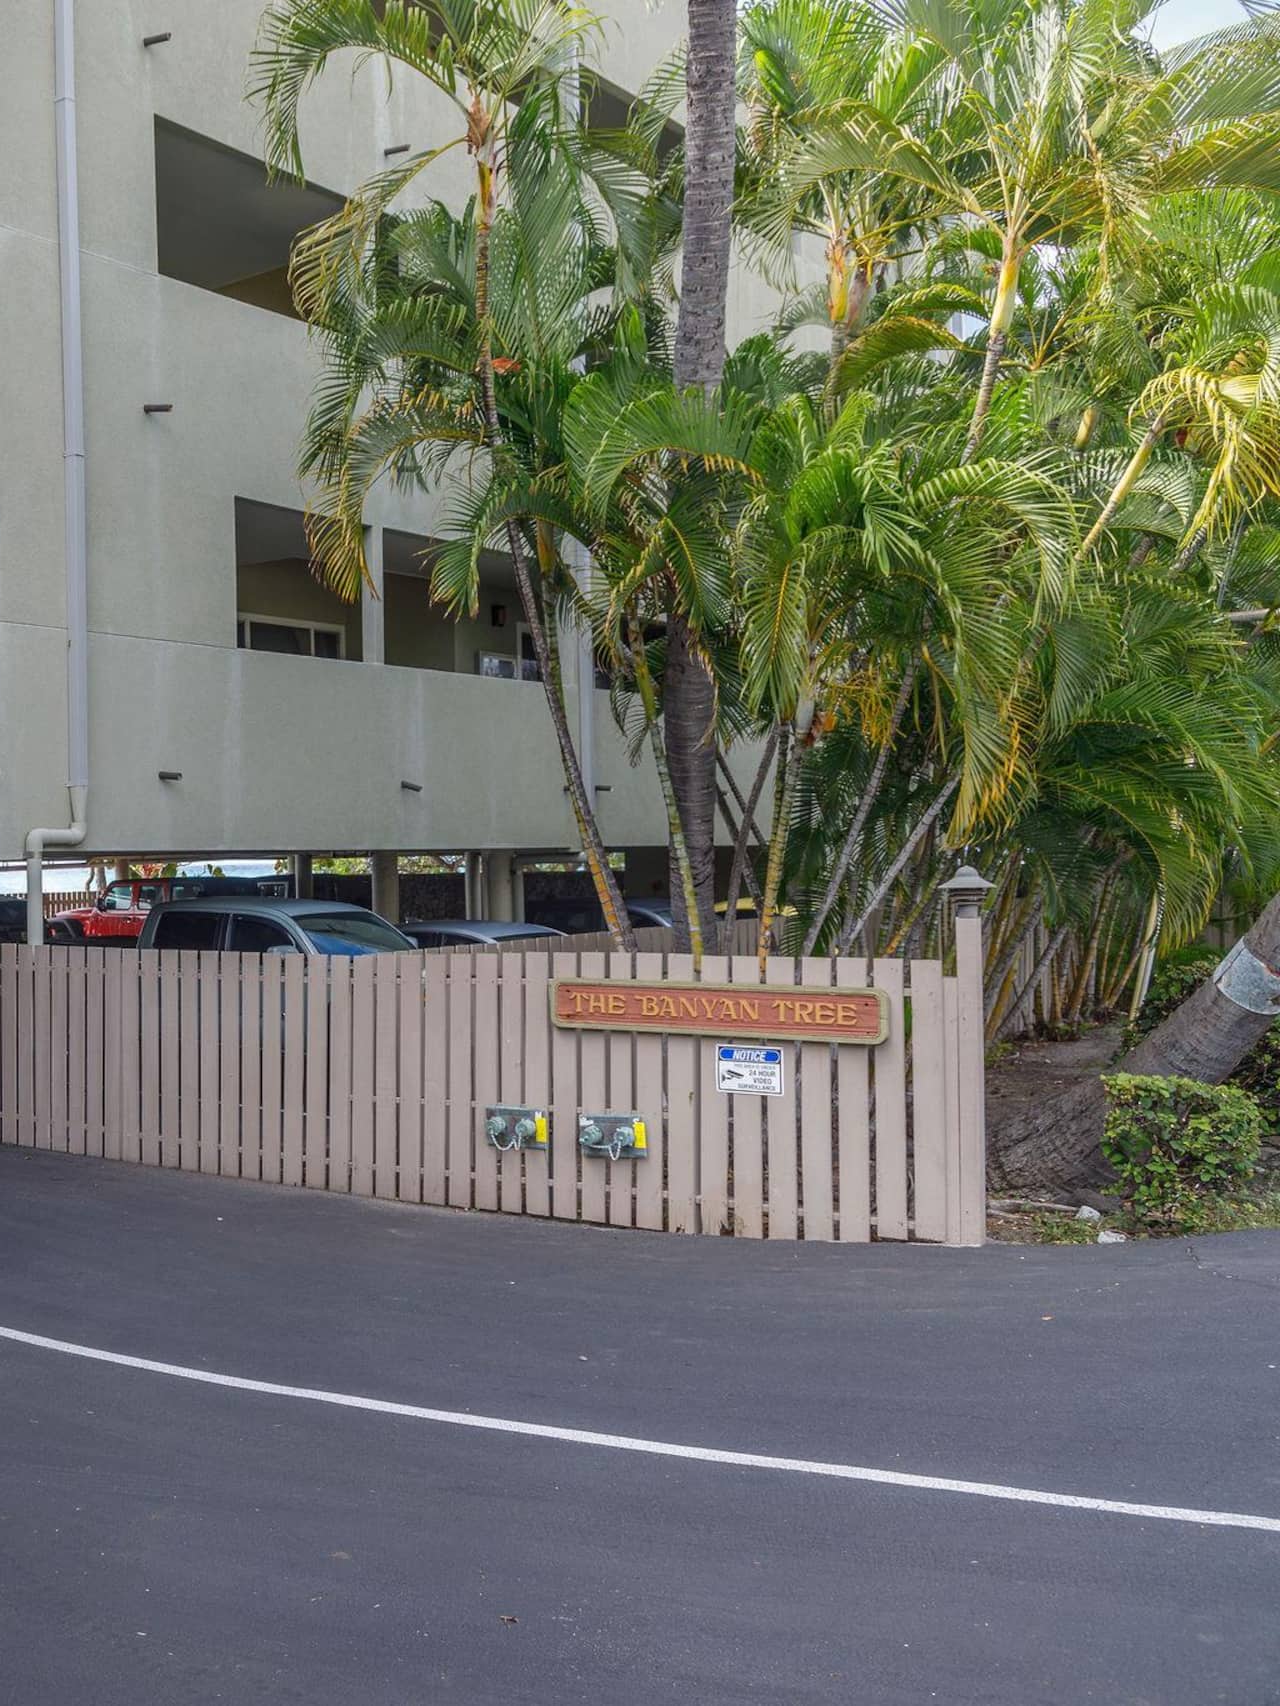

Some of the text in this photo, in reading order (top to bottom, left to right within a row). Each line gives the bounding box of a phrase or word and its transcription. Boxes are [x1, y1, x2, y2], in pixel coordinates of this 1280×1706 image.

[570, 992, 858, 1026] THE BANYAN TREE
[732, 1050, 767, 1062] NOTICE
[758, 1070, 776, 1078] HOUR
[753, 1077, 772, 1085] VIDEO
[738, 1083, 776, 1091] SURVEILLANCE
